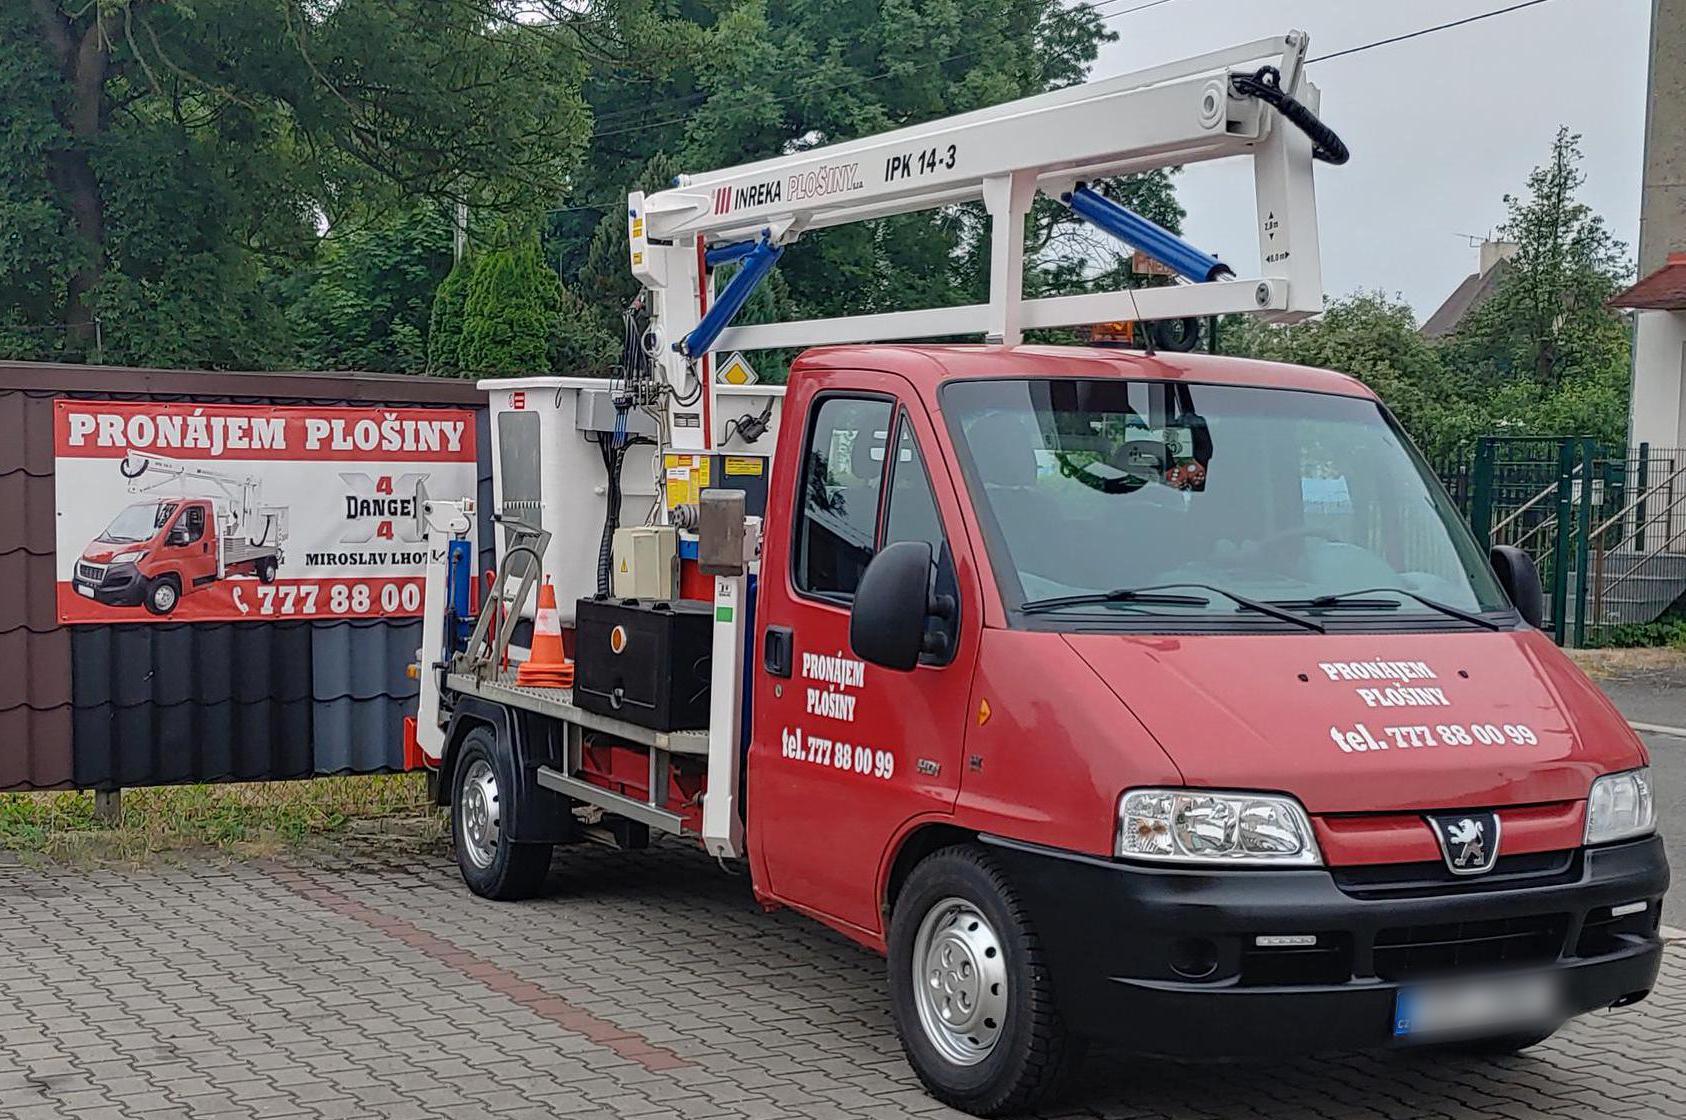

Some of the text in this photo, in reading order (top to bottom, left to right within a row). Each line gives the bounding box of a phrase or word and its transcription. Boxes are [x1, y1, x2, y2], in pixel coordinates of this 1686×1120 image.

[885, 144, 957, 182] IPK 14-3
[734, 180, 781, 210] INREKA
[787, 163, 859, 202] PLOŠINY
[68, 408, 465, 456] PRONÁJEM PLOŠINY
[376, 476, 394, 495] 4
[376, 521, 394, 540] 4
[305, 552, 388, 566] MIROSLAV
[257, 583, 421, 614] 777 88 00
[802, 650, 865, 691] PRONÁJEM
[1318, 657, 1438, 683] PRONÁJEM
[806, 684, 857, 722] PLOŠINY
[1356, 681, 1450, 707] PLOŠINY
[781, 726, 895, 780] tel. 777 88 00 99
[1330, 723, 1538, 753] tel. 777 88 00 99
